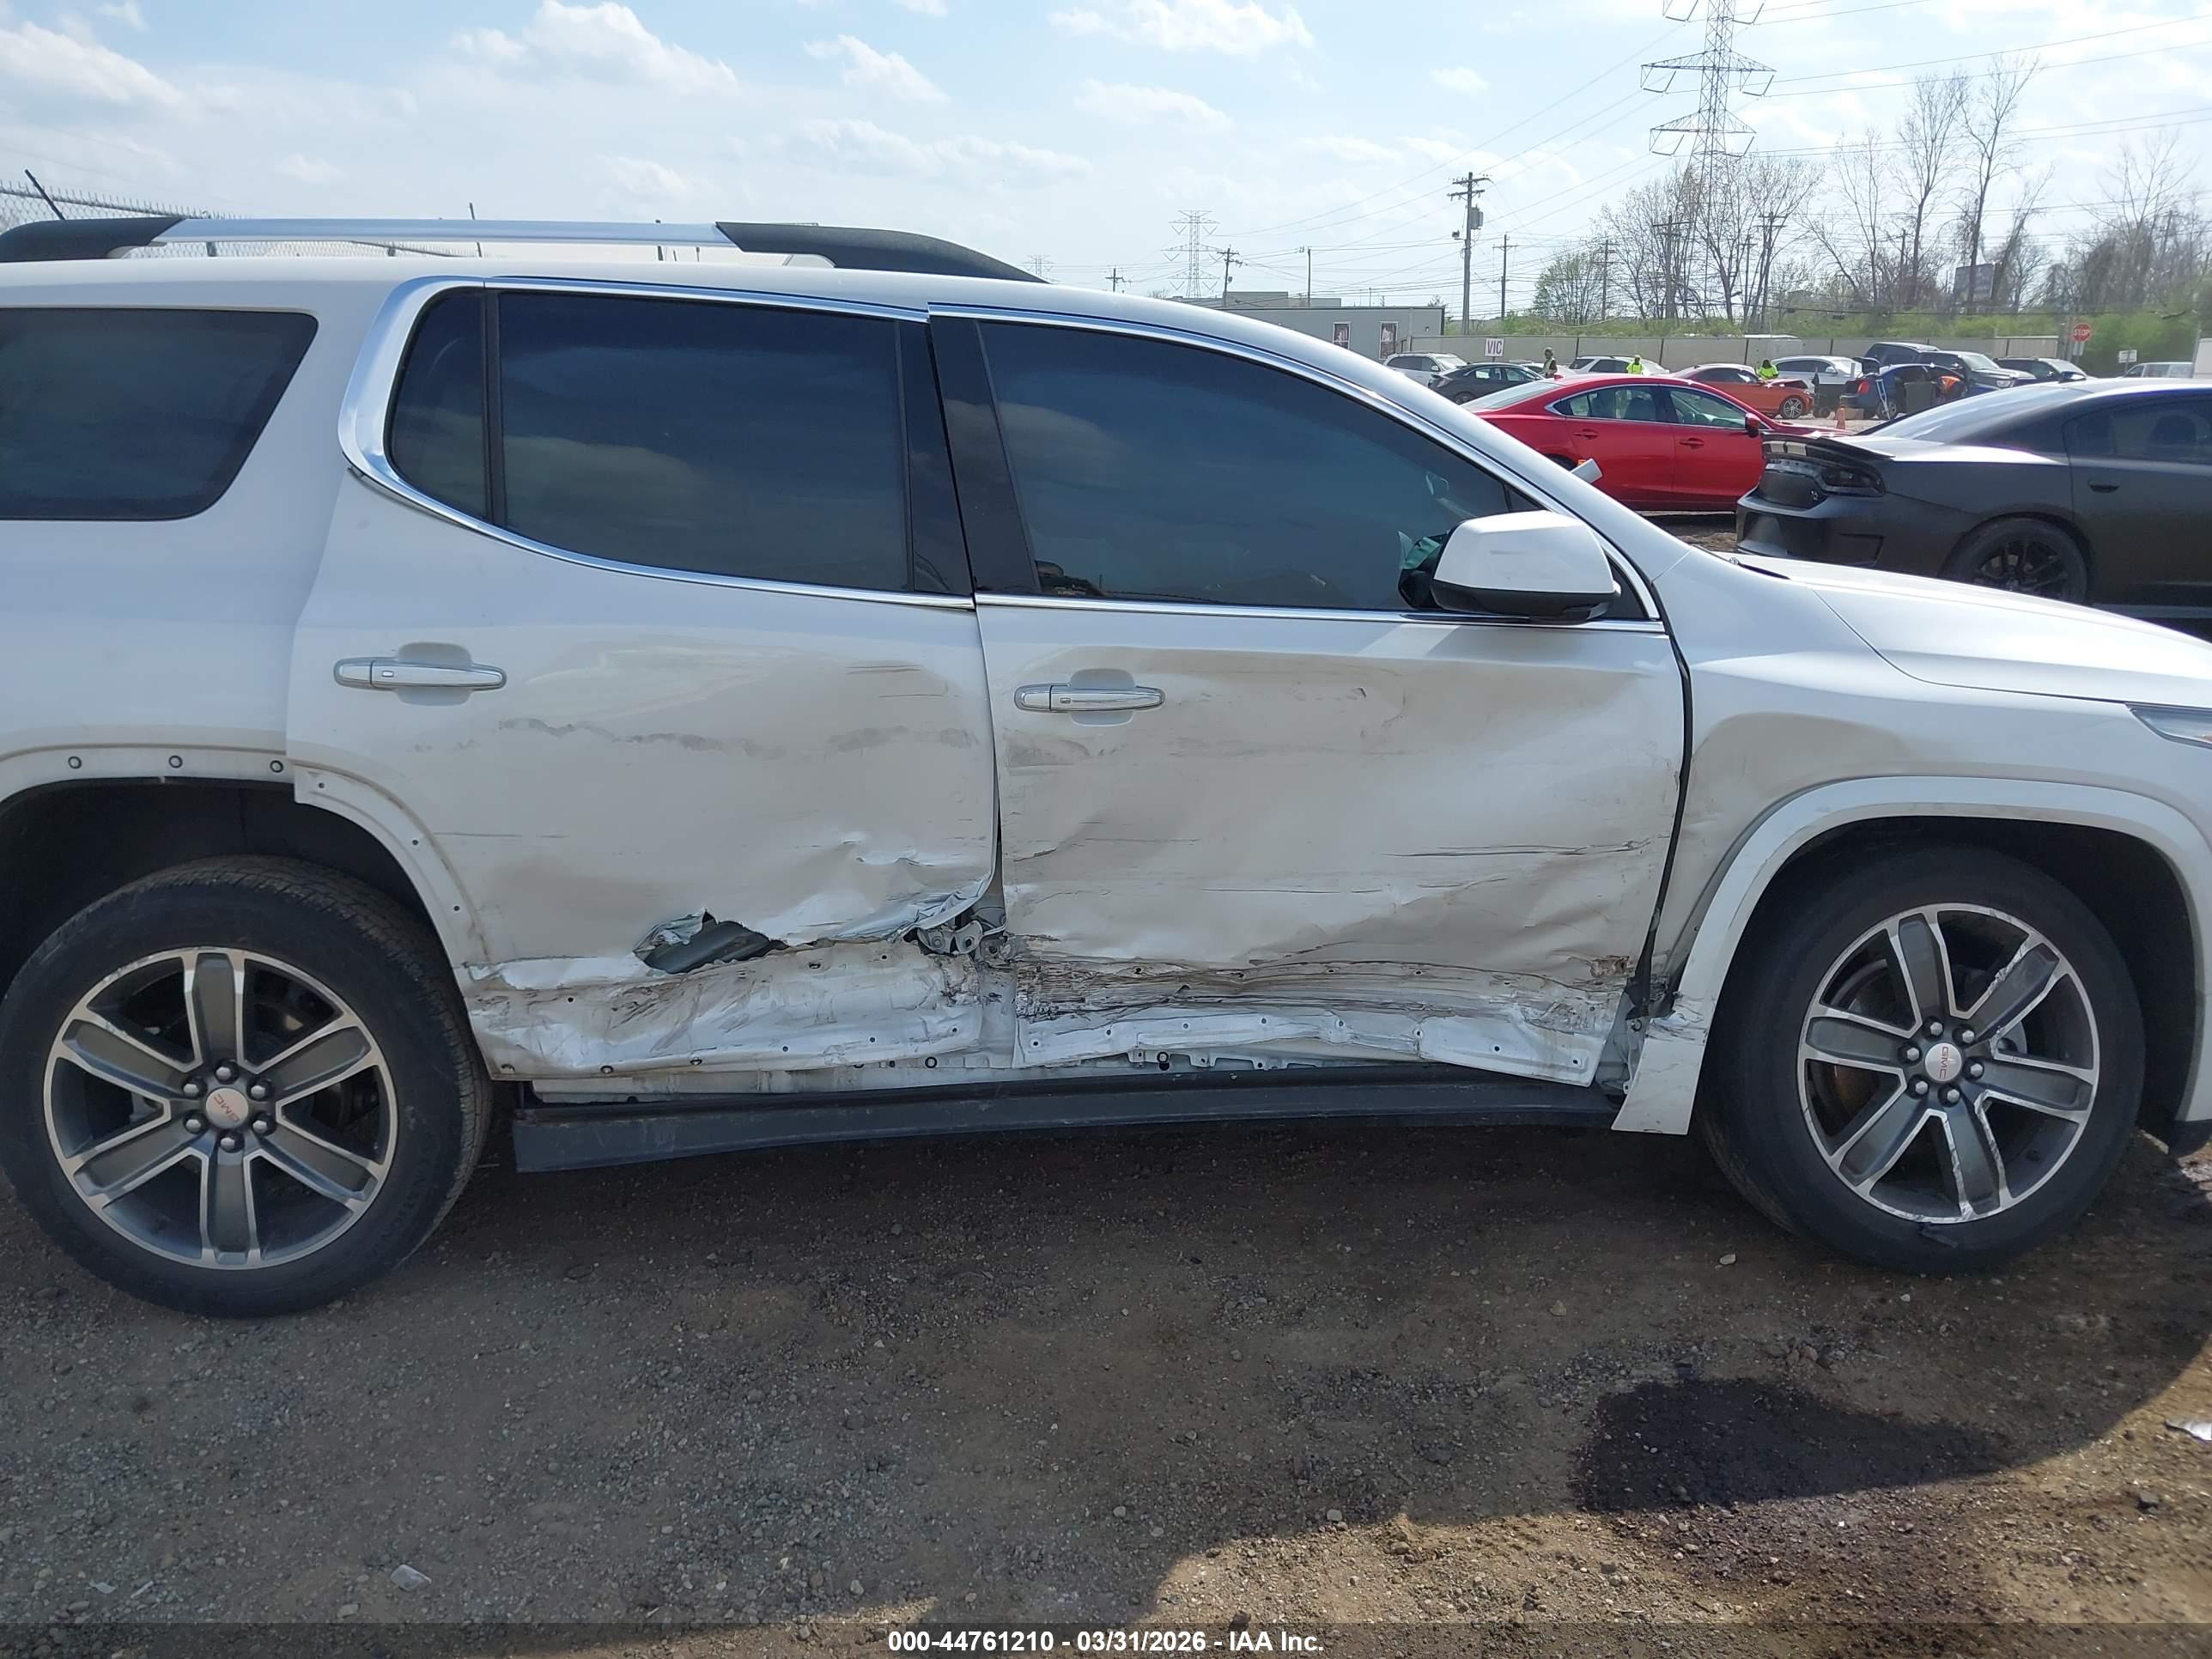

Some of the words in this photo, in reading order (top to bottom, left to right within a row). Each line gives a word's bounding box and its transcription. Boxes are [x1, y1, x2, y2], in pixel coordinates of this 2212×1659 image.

[1487, 340, 1503, 355] VIC
[1939, 1046, 1949, 1079] GMC
[213, 1093, 240, 1123] GMC
